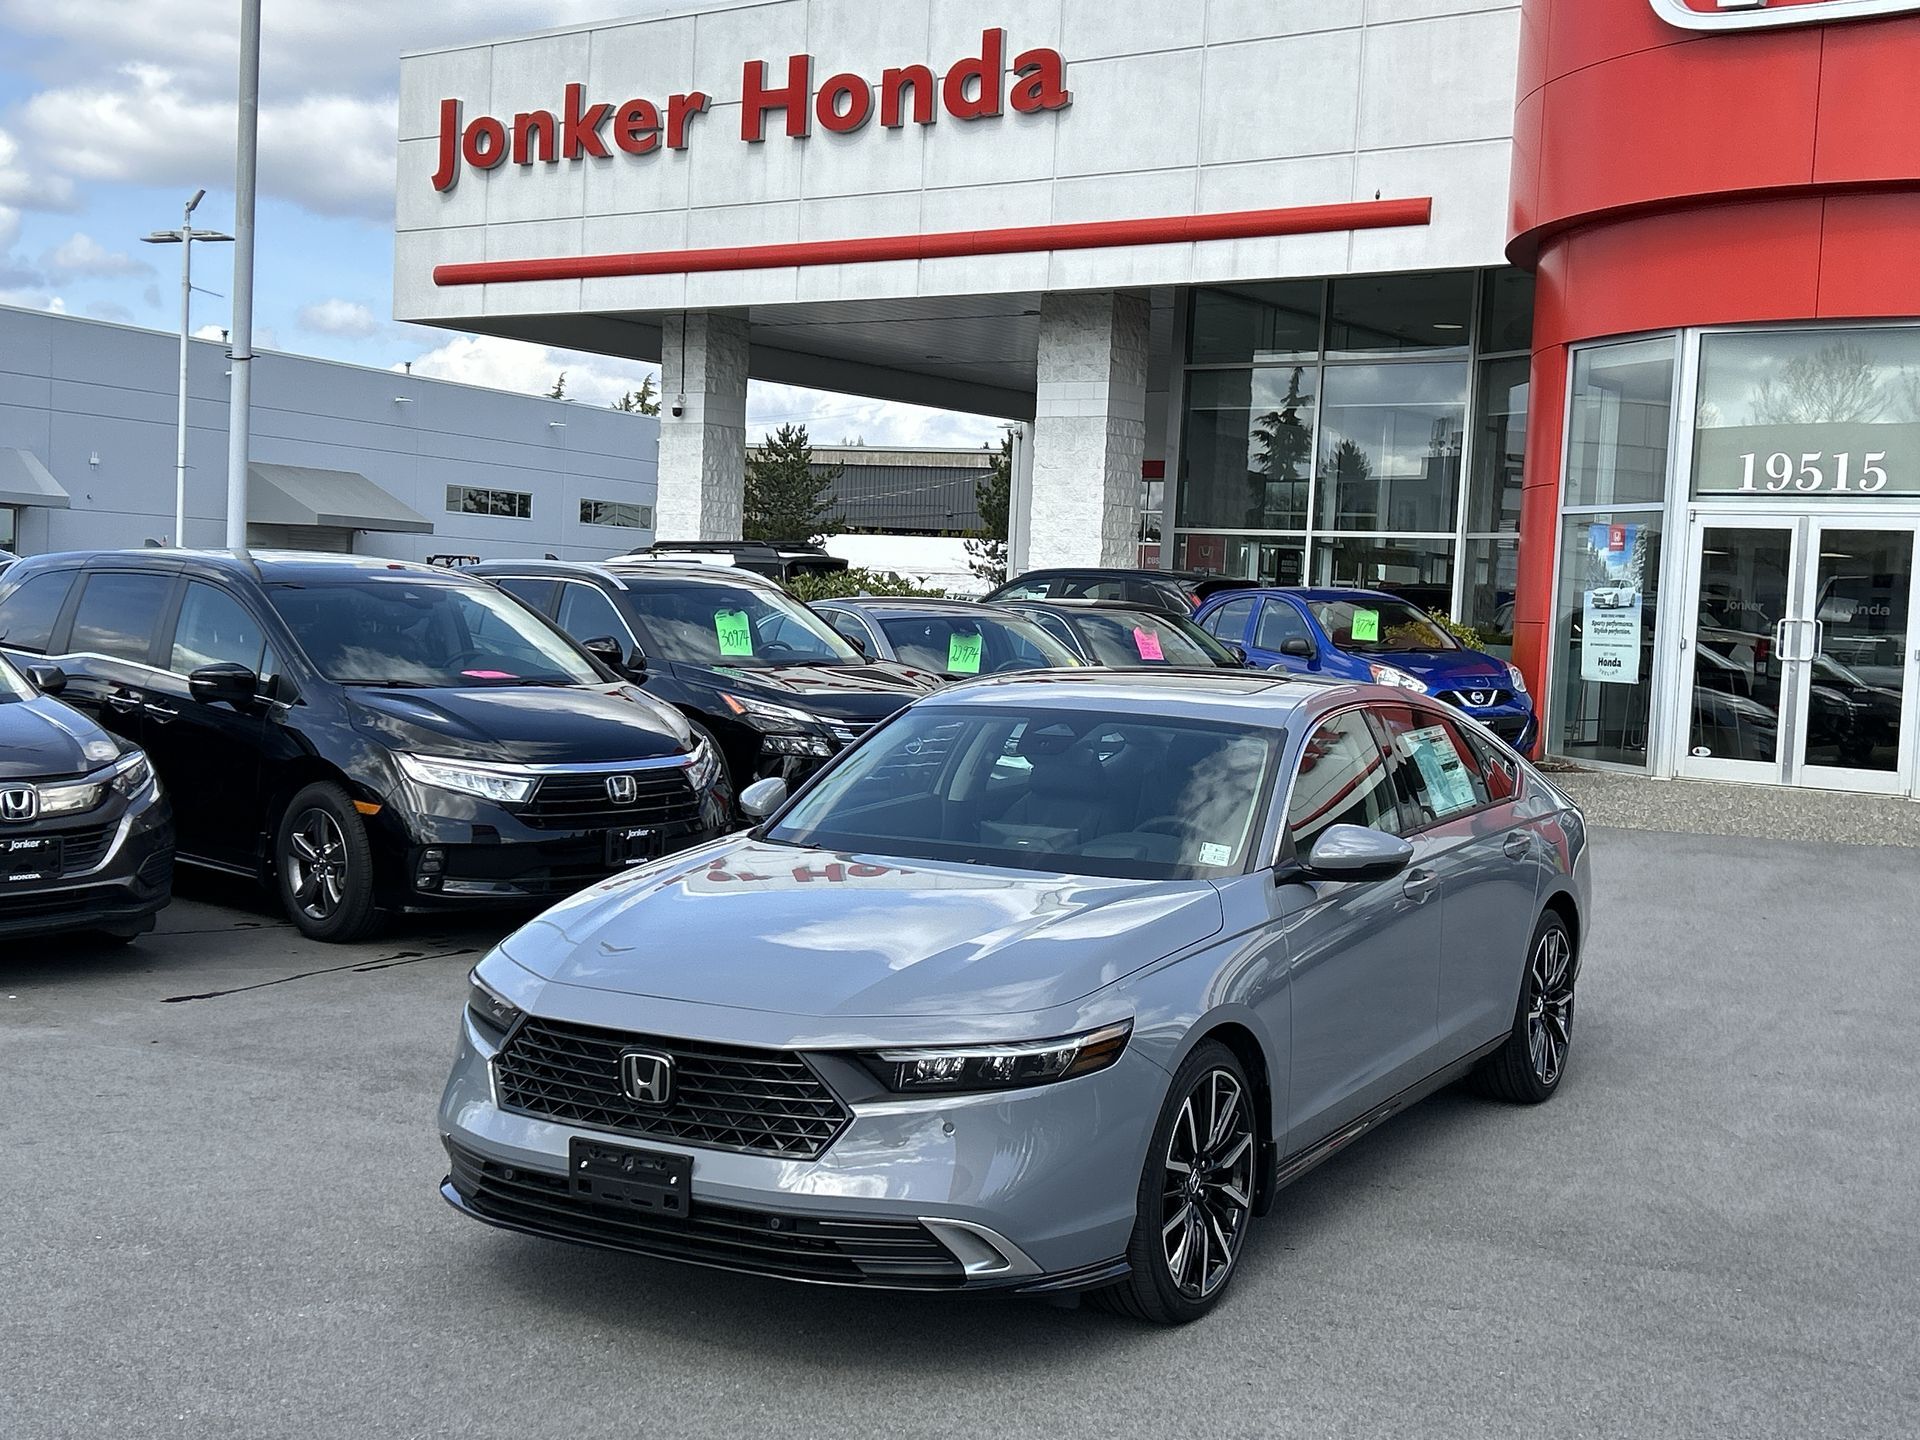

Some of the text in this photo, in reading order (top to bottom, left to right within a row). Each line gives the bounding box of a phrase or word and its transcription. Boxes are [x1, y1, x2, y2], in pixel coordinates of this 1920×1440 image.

[432, 28, 1073, 192] Jonker Honda
[1738, 451, 1888, 492] 19515
[1723, 600, 1764, 613] Jonker
[1597, 656, 1622, 668] Honda
[626, 829, 649, 840] Jonker
[9, 840, 41, 852] Jonker
[9, 873, 41, 881] HONDA
